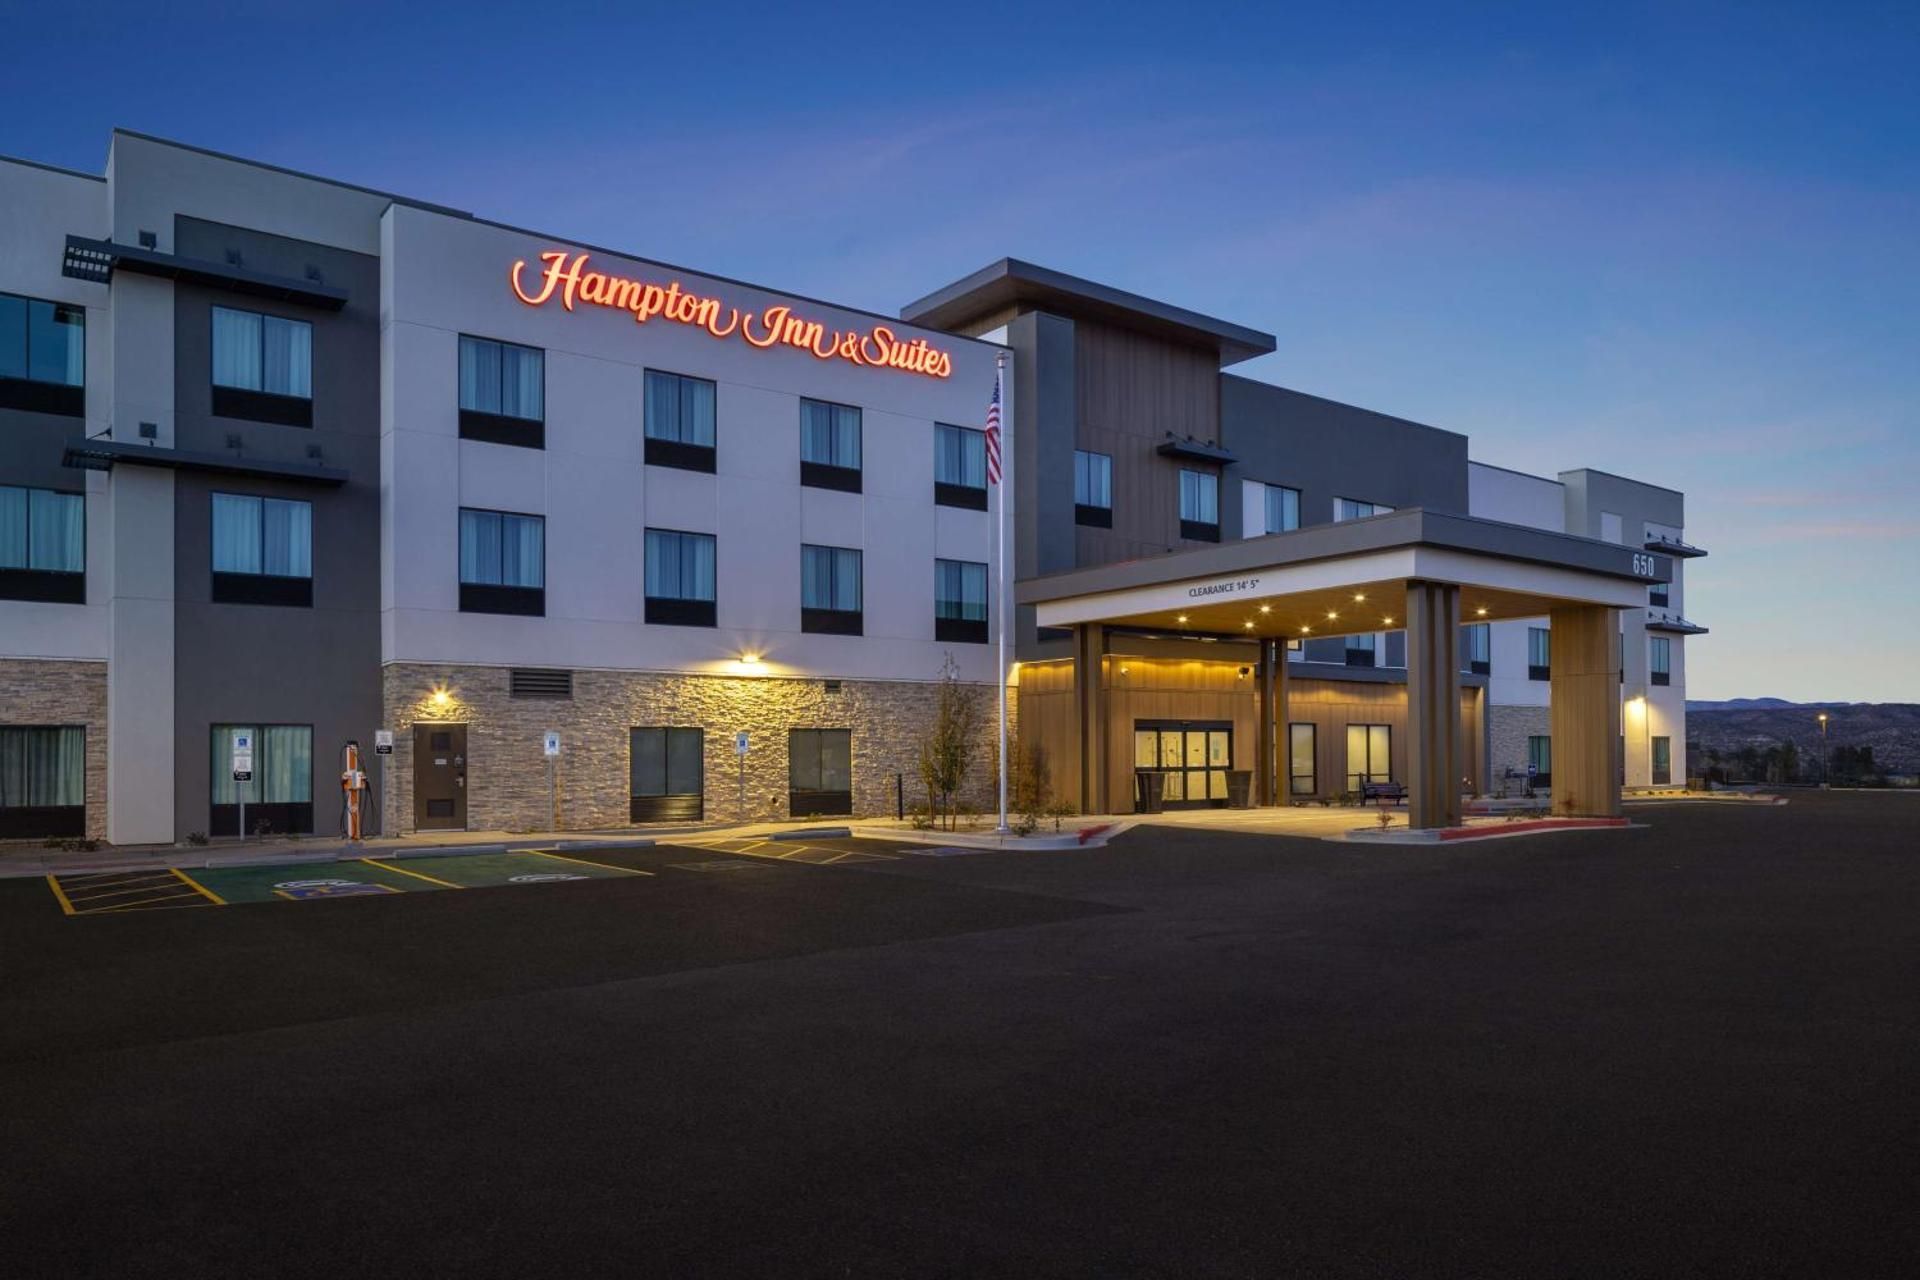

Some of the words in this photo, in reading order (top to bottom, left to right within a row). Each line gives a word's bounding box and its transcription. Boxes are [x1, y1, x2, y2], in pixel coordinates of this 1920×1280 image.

[511, 251, 737, 337] Hampton
[741, 304, 840, 359] Inn
[1633, 553, 1655, 577] 650
[1188, 583, 1234, 597] CLEARANCE
